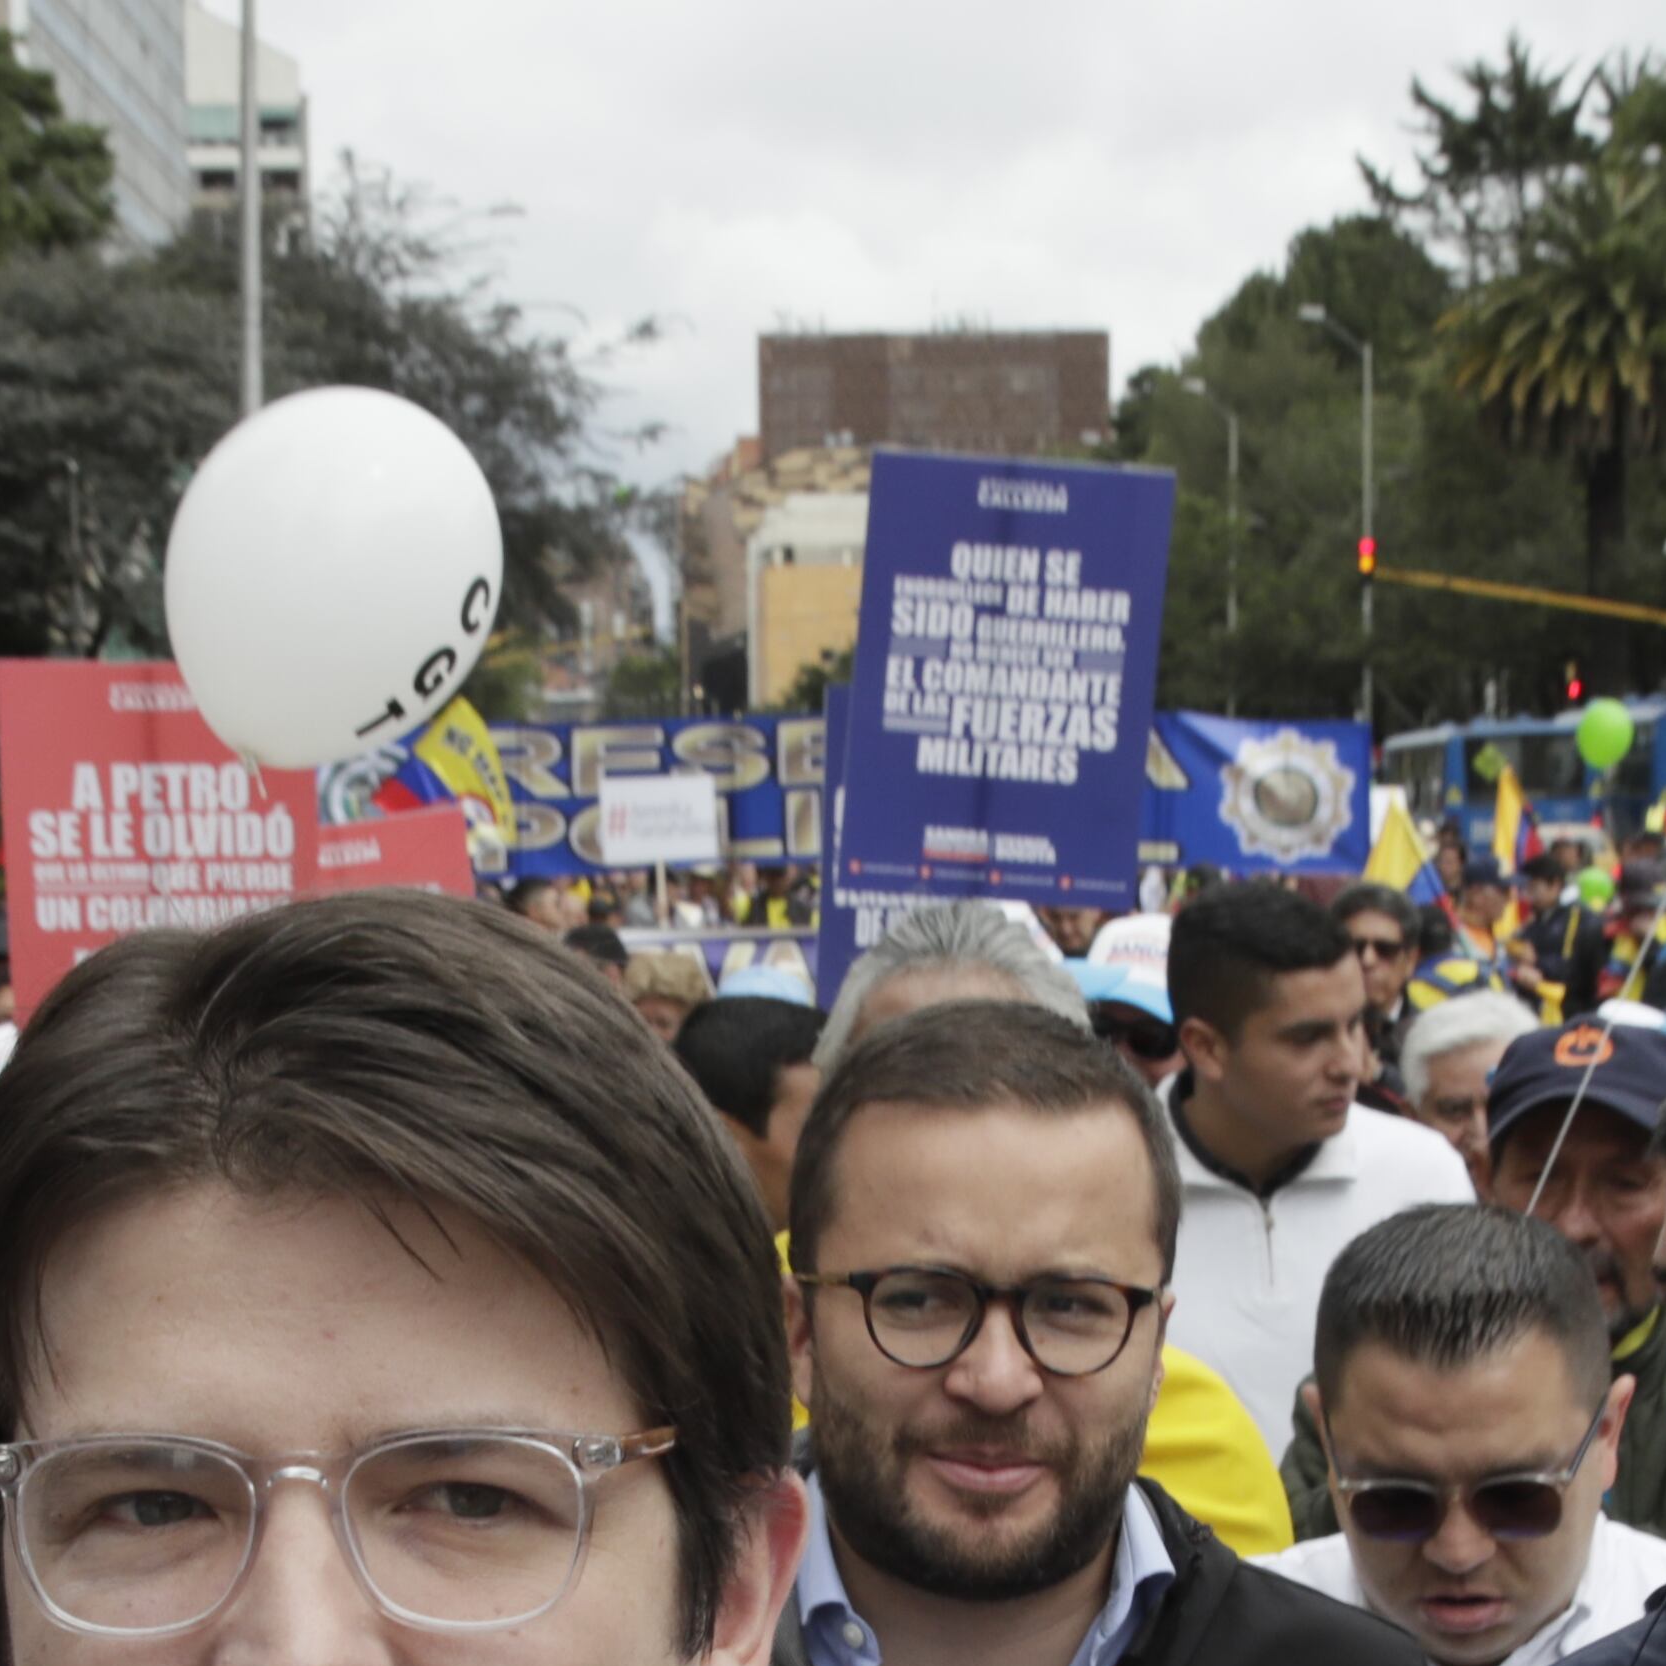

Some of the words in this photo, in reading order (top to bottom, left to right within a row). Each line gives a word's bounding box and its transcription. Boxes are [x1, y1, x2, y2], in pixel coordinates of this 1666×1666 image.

[951, 541, 1040, 586] QUIEN
[1044, 549, 1082, 587] SE
[891, 599, 974, 639] SIDO
[1006, 584, 1039, 618] DE
[1044, 587, 1131, 625] HABER
[886, 655, 914, 690] EL
[923, 659, 1122, 708] COMANDANTE
[884, 690, 909, 714] DE
[912, 692, 948, 717] LAS
[951, 697, 1118, 752] FUERZAS
[917, 736, 1078, 786] MILITARES
[72, 762, 104, 811] A
[110, 762, 250, 811] PETRO
[29, 810, 82, 858] SE
[89, 811, 135, 858] LE
[143, 802, 295, 858] OLVIDÓ
[152, 862, 200, 893] QUE
[206, 862, 293, 892] PIERDE
[35, 895, 82, 932] UN
[87, 894, 291, 932] COLOMBIA
